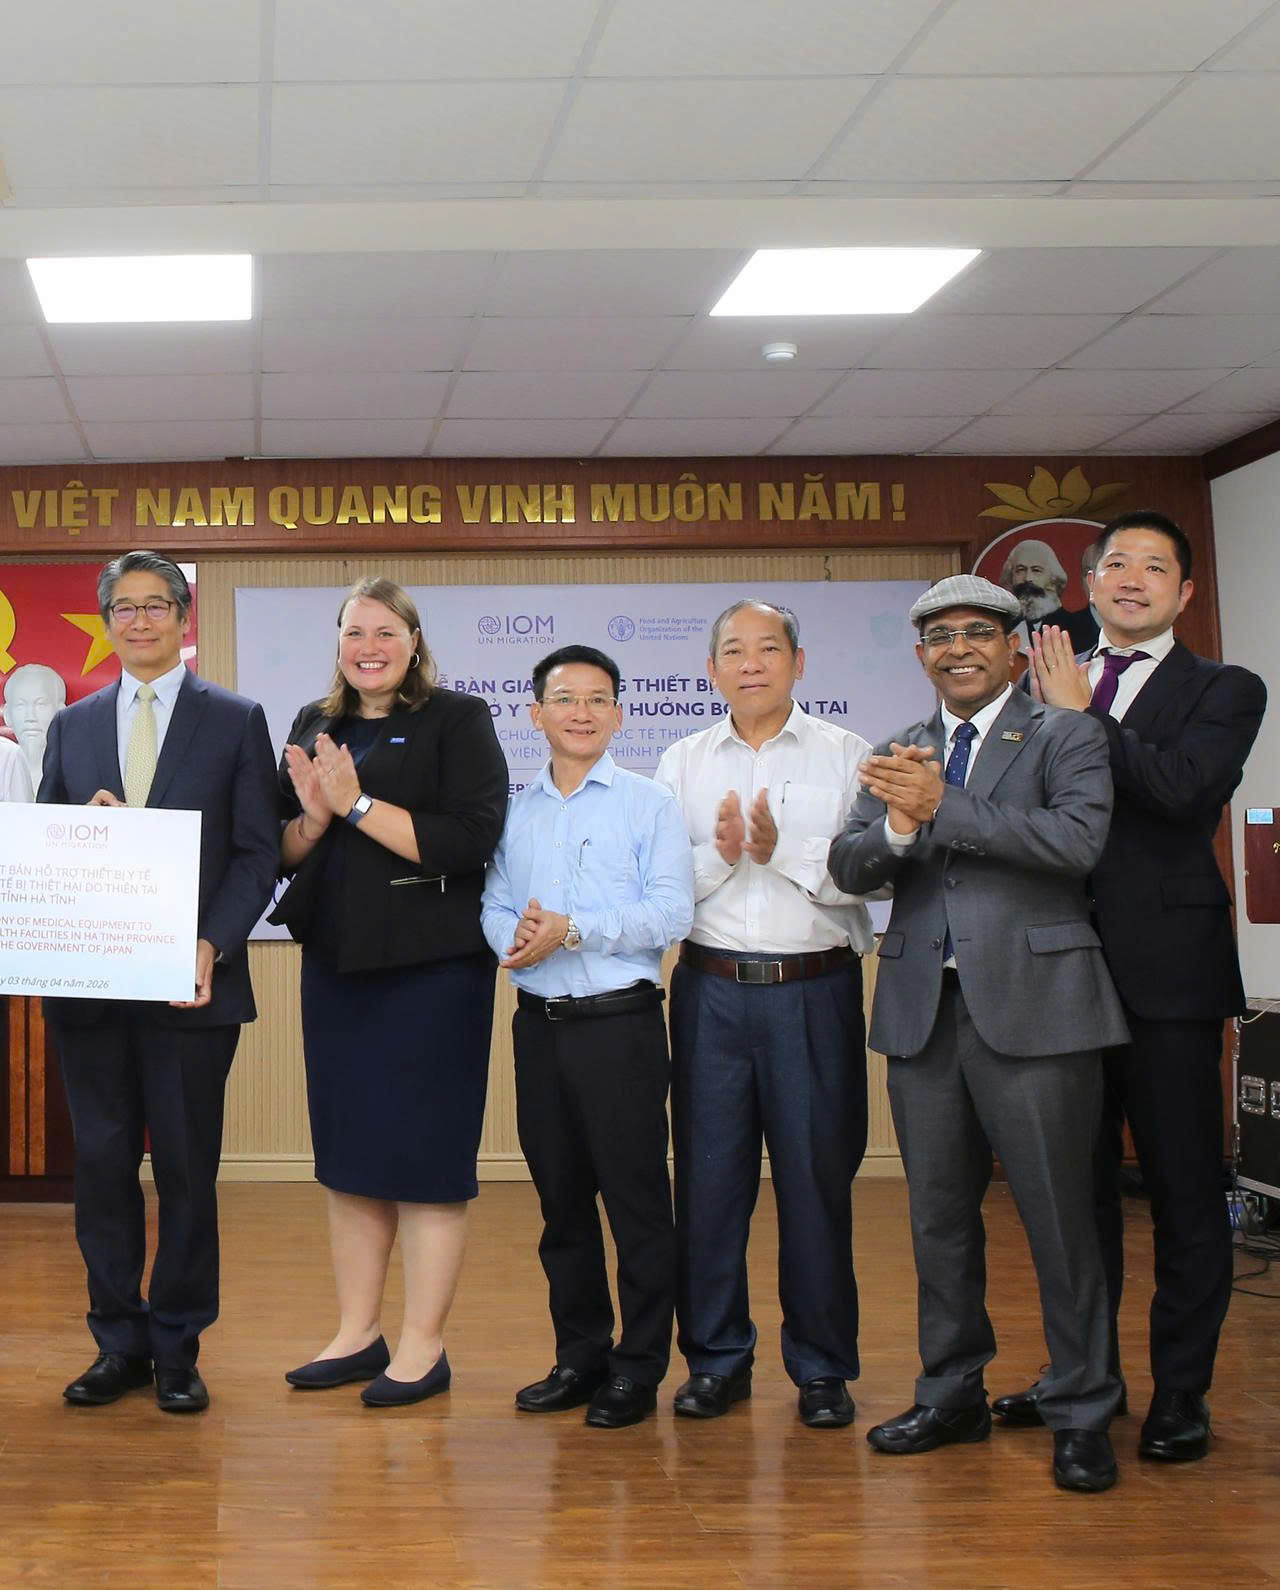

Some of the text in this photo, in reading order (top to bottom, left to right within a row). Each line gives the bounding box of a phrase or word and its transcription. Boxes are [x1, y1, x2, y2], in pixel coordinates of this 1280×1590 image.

[11, 481, 119, 536] VIỆT
[136, 487, 255, 526] NAM
[268, 485, 442, 531] QUANG
[461, 484, 576, 524] VINH
[591, 473, 745, 523] MUÔN
[506, 615, 554, 634] IOM
[478, 636, 555, 644] UN MIGRATION
[455, 677, 496, 694] BÀN
[502, 680, 533, 693] GIA
[632, 674, 691, 692] THIẾT
[508, 704, 520, 717] Y
[630, 697, 705, 716] HƯỞNG
[815, 700, 848, 714] TAI
[70, 824, 109, 841] IOM
[9, 864, 32, 876] BẢN
[35, 864, 52, 877] HỖ
[81, 867, 113, 880] THIẾT
[115, 869, 125, 882] BỊ
[127, 871, 135, 881] Y
[138, 868, 151, 881] TẾ
[0, 876, 13, 889] TẾ
[16, 879, 26, 891] BỊ
[29, 878, 61, 892] THIỆT
[64, 881, 81, 894] HẠI
[85, 882, 103, 893] DO
[106, 882, 138, 895] THIÊN
[141, 884, 157, 895] TAI
[0, 890, 27, 903] TỈNH
[31, 893, 47, 904] HÀ
[50, 893, 76, 905] TĨNH
[17, 916, 31, 926] OF
[33, 918, 76, 928] MEDICAL
[78, 920, 136, 931] EQUIPMENT
[139, 922, 152, 931] TO
[20, 929, 68, 940] FACILITIES
[71, 931, 81, 940] IN
[84, 932, 97, 941] HA
[101, 933, 124, 942] TINH
[127, 934, 175, 944] PROVINCE
[17, 941, 85, 953] GOVERNMENT
[88, 944, 101, 953] OF
[104, 945, 132, 955] JAPAN
[7, 977, 19, 985] 03
[21, 976, 48, 988] tháng
[63, 979, 84, 988] năm
[86, 980, 109, 989] 2026
